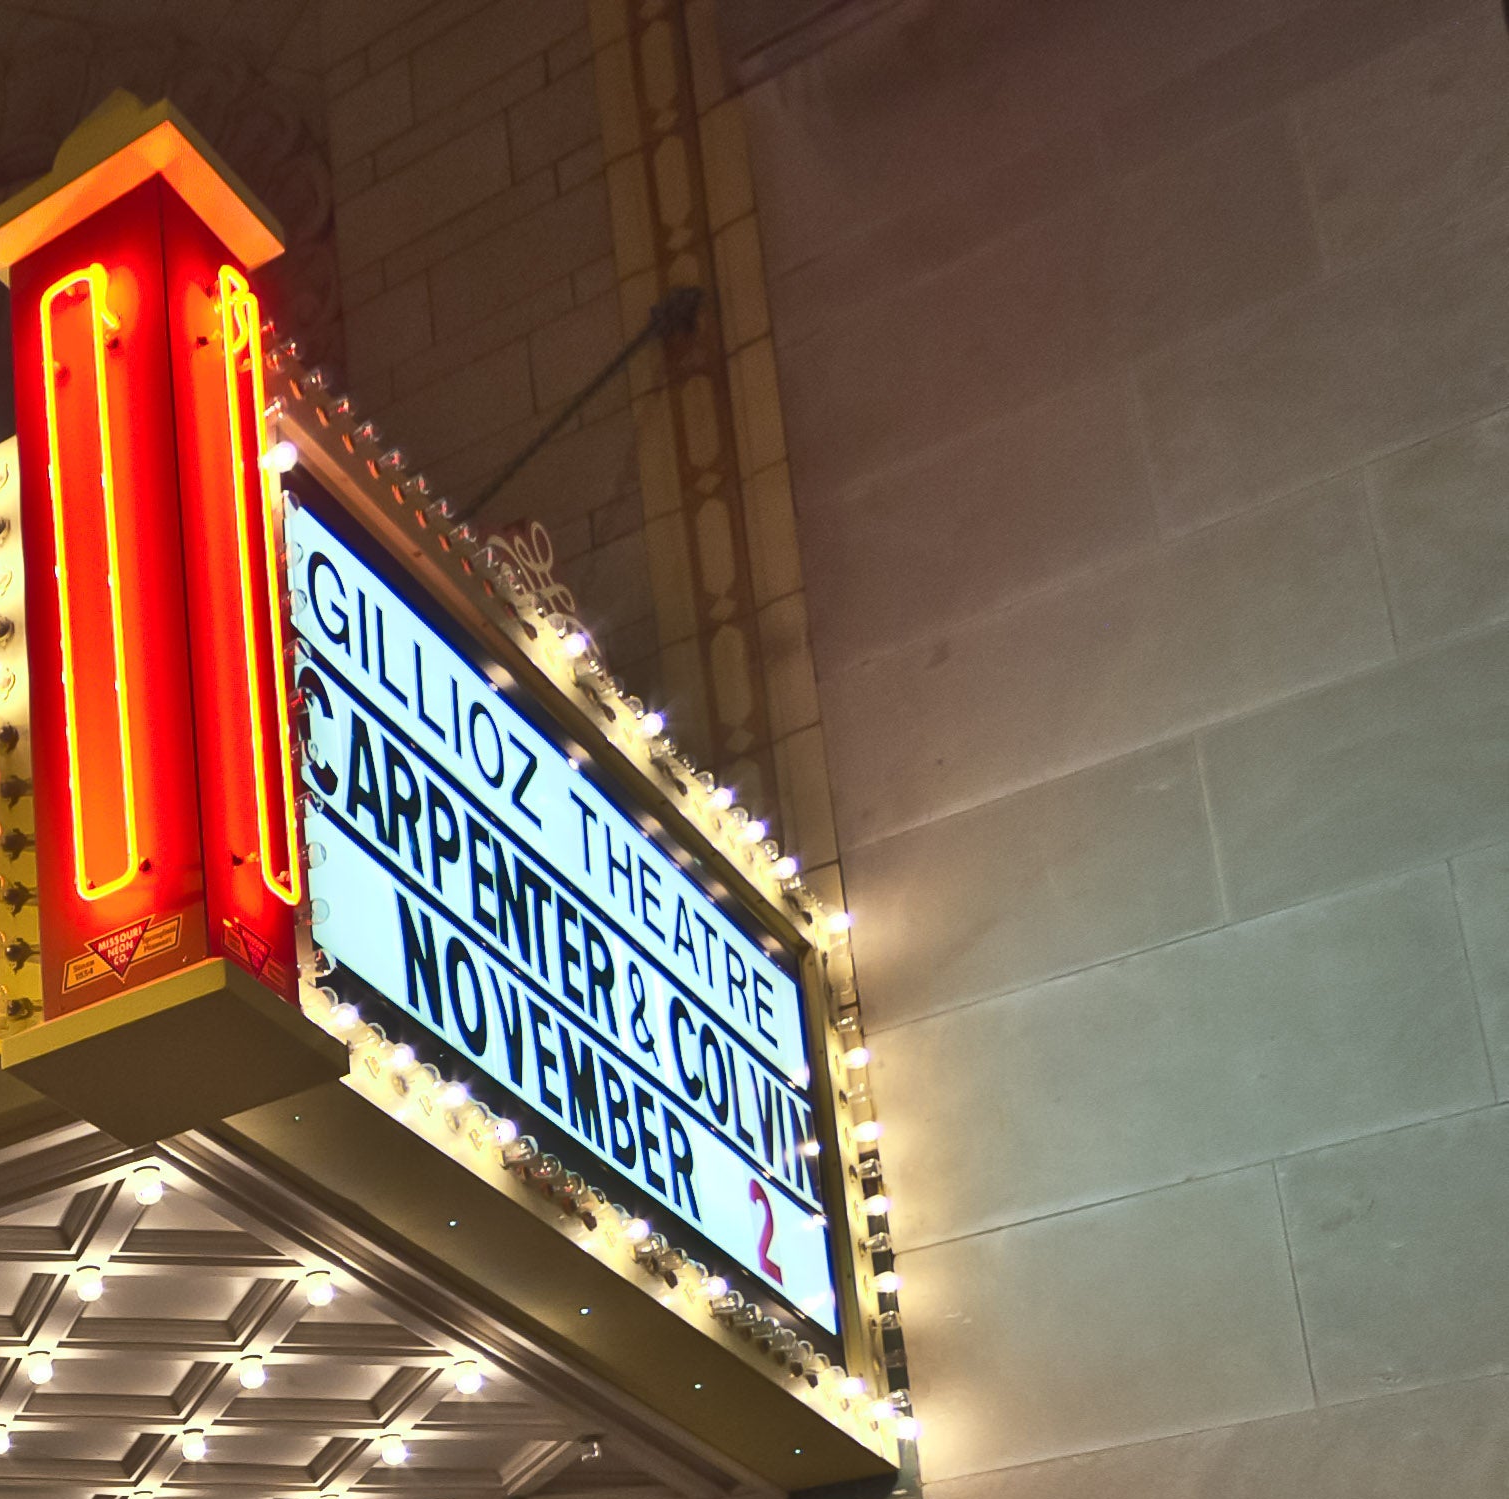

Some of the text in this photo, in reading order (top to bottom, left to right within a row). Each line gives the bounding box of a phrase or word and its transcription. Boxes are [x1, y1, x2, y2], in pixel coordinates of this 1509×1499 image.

[98, 926, 143, 951] MISSOURI
[107, 940, 134, 958] NEON
[297, 665, 818, 1203] CARPENTER & COLVIN
[308, 551, 779, 1049] GILLIOZ THEATRE
[395, 889, 783, 1286] NOVEMBER 2
